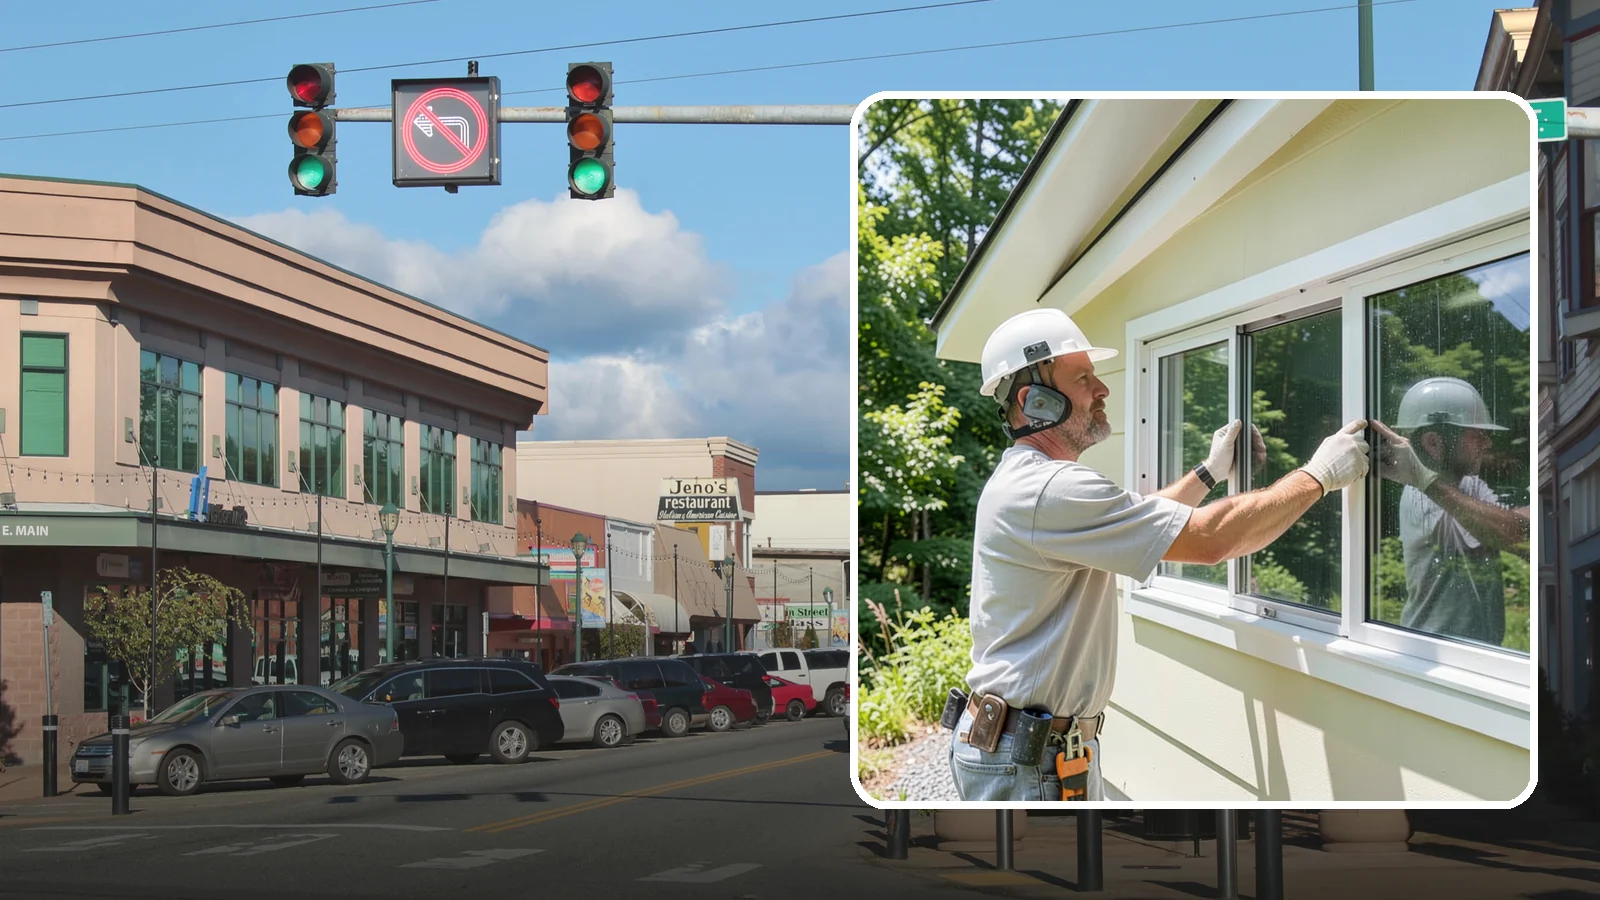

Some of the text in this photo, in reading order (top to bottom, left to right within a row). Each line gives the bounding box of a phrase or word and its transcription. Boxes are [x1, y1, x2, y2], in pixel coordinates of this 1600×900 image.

[670, 480, 727, 494] Jeno's
[665, 496, 731, 509] restaurant
[658, 510, 682, 519] Italian
[686, 510, 715, 519] American
[715, 509, 737, 519] Cuisine
[2, 525, 49, 536] E. MAIN
[797, 607, 828, 617] Street
